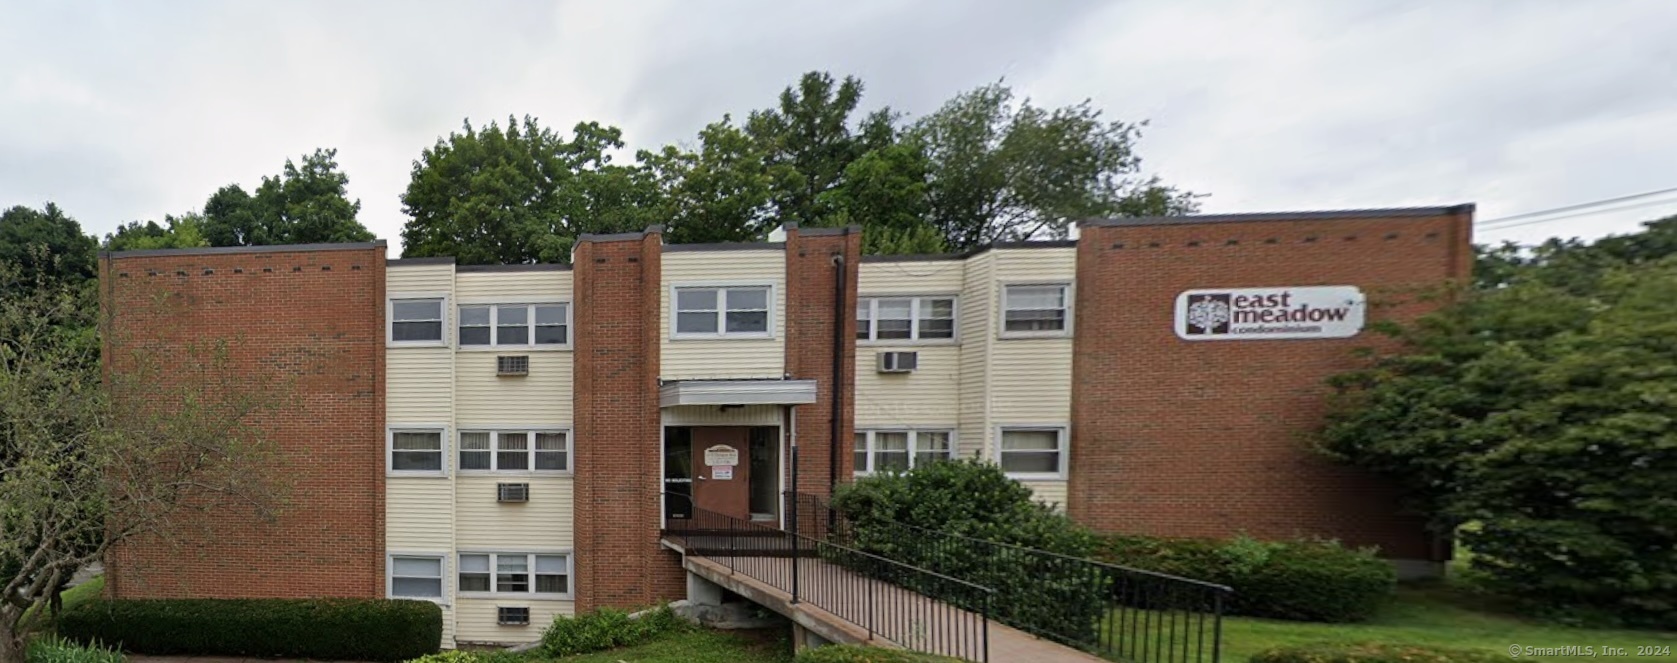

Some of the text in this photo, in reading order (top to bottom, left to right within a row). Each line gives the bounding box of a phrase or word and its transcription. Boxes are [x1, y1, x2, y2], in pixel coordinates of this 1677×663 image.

[1235, 291, 1291, 309] east
[1234, 304, 1349, 323] meadow
[1233, 324, 1323, 335] condominium
